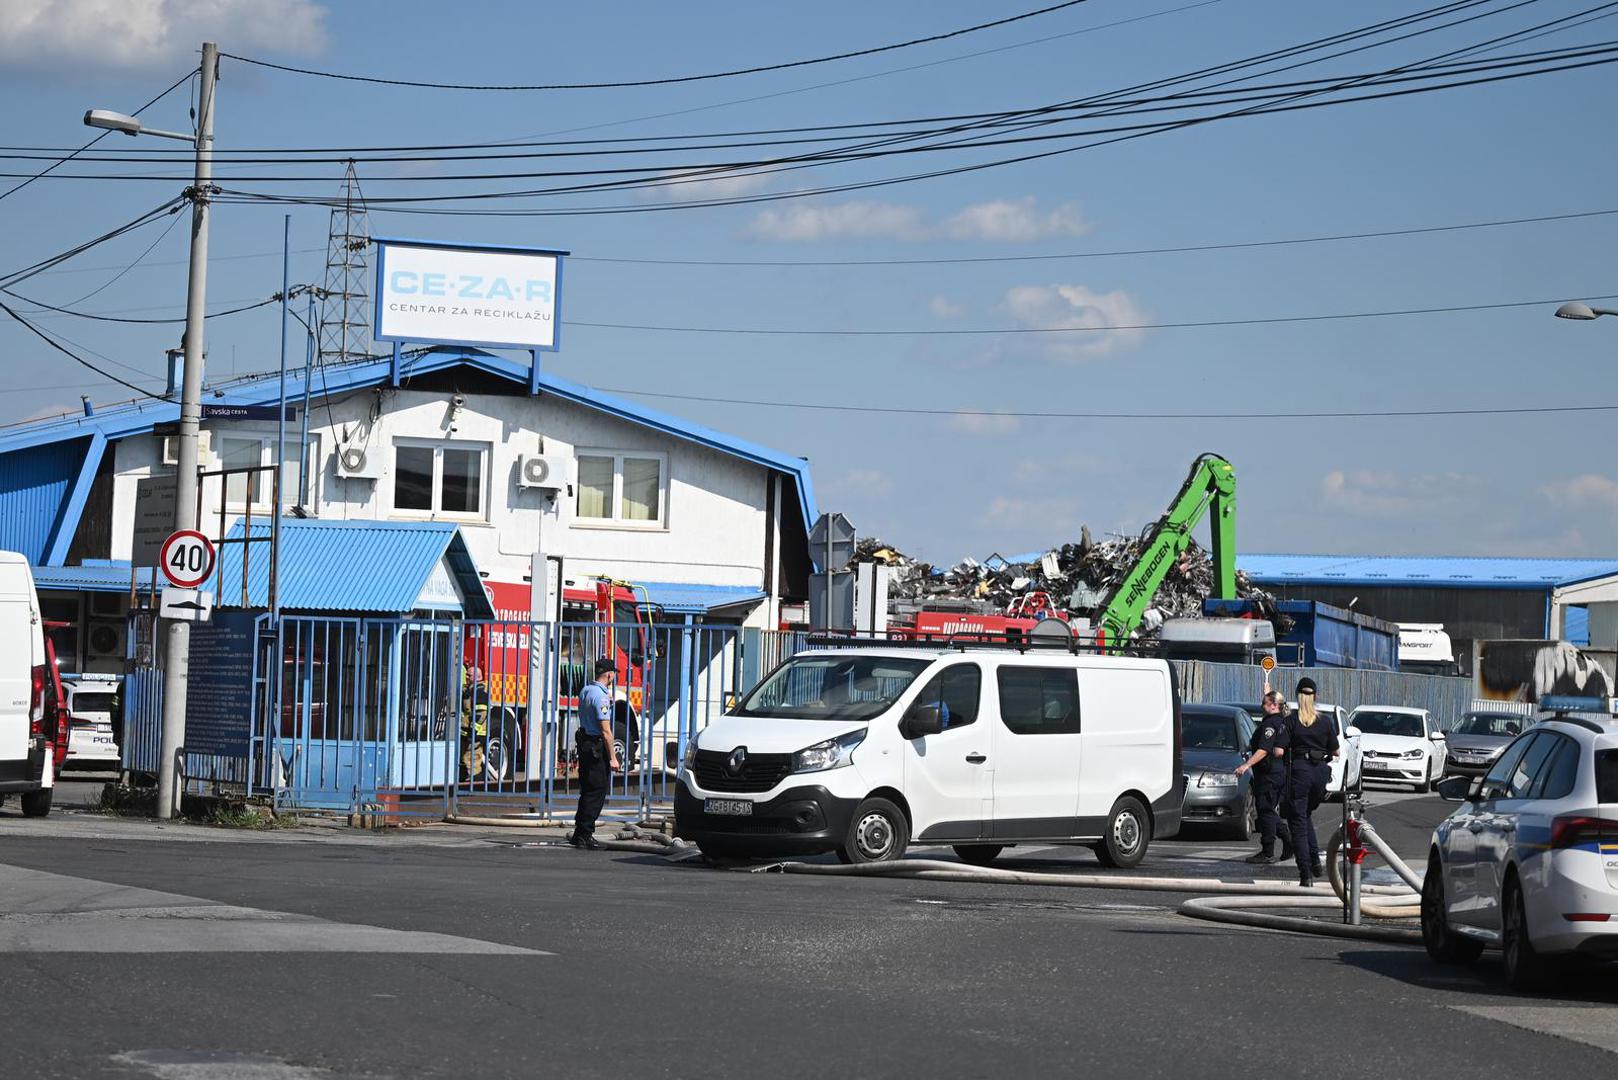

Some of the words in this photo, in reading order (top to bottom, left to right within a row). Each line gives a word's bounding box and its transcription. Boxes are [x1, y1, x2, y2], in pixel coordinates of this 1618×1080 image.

[390, 303, 446, 314] CENTAR
[451, 307, 468, 315] ZA
[474, 309, 551, 321] RECIKLAŽU
[171, 544, 203, 572] 40
[1125, 541, 1171, 608] SENNEBOGEN
